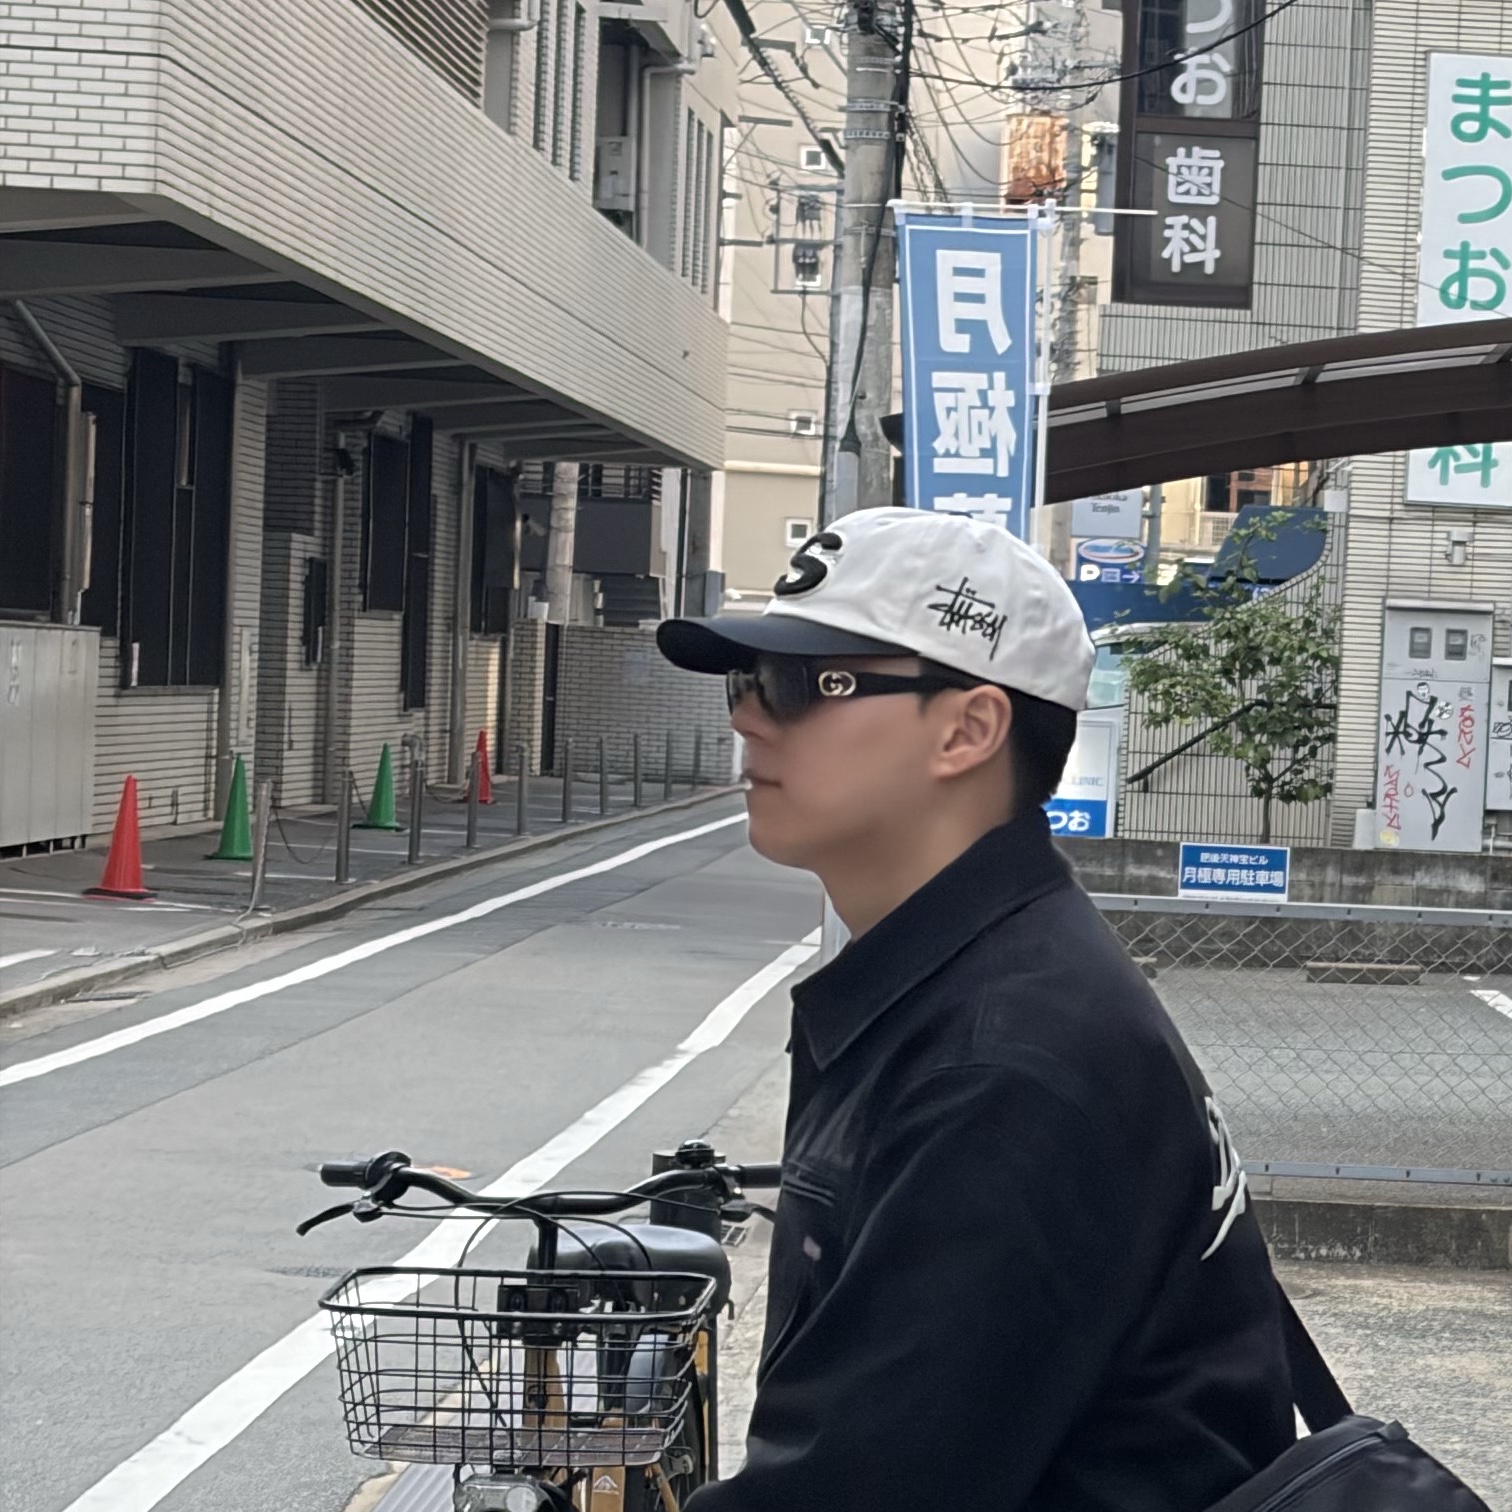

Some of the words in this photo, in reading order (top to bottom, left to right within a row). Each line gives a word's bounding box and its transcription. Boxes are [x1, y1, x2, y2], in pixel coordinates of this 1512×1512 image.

[1182, 866, 1285, 888] 月極専用駐車場
